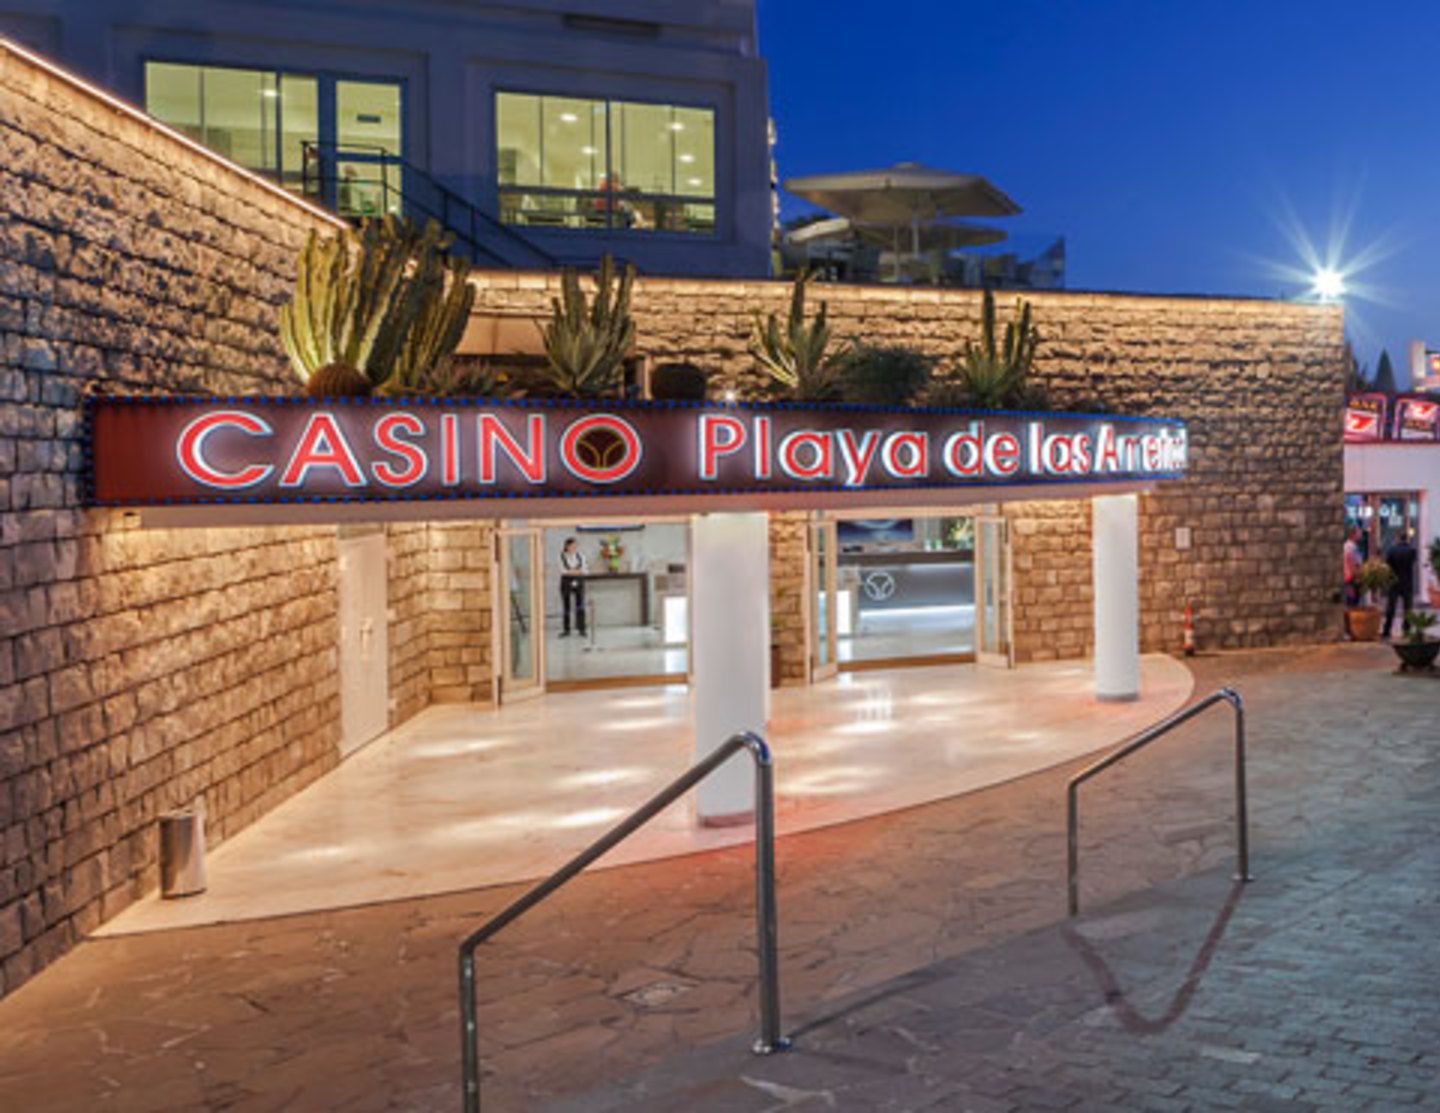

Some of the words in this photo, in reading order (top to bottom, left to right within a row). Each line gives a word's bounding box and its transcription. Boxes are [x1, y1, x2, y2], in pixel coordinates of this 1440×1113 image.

[176, 411, 642, 488] CASINO
[699, 414, 929, 486] Playa
[944, 420, 1020, 477] de
[1029, 421, 1092, 475] las
